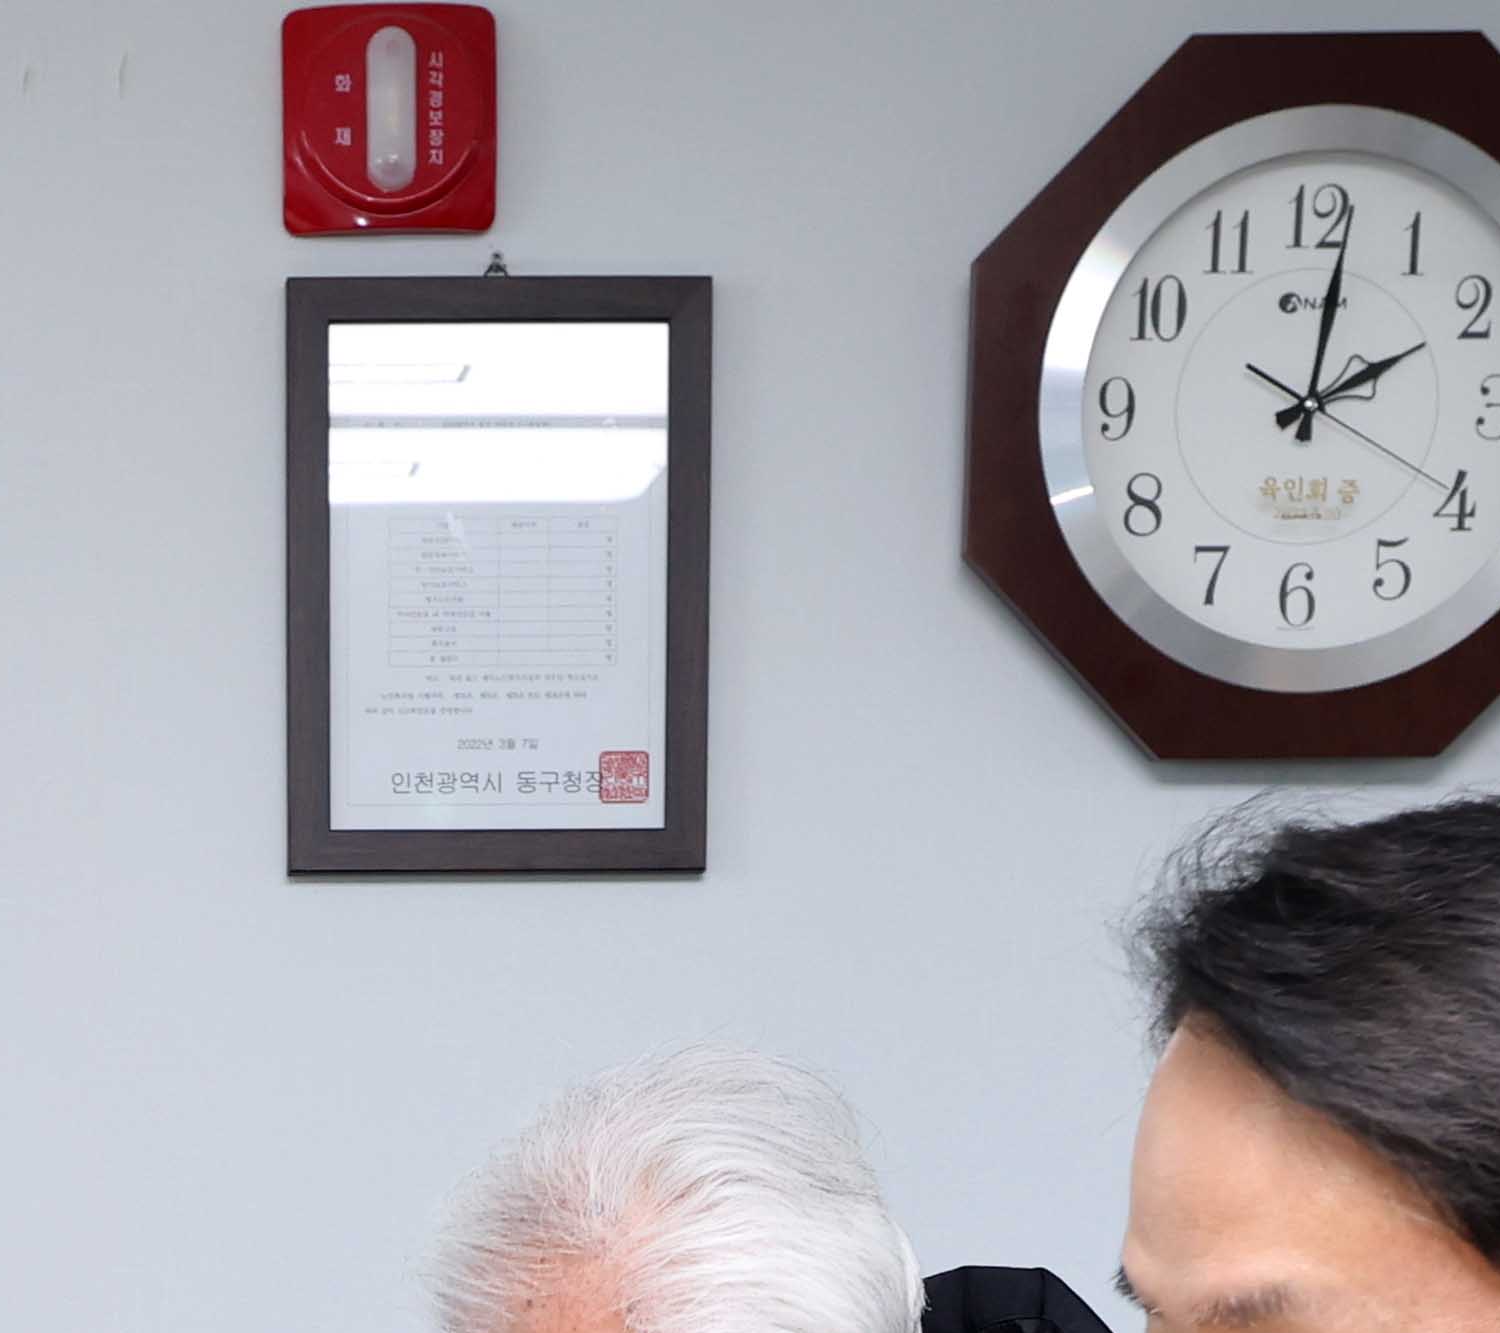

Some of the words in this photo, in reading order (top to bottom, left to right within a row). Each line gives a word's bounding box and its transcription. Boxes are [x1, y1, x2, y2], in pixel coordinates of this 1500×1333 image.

[428, 51, 445, 165] 시각경보장치
[1204, 210, 1255, 276] 11
[1284, 183, 1352, 250] 12
[1400, 210, 1425, 277] 1
[1129, 274, 1188, 342] 10
[1455, 274, 1494, 341] 2
[1098, 375, 1137, 441] 9
[1123, 472, 1164, 538] 8
[1432, 468, 1478, 533] 4
[1193, 544, 1231, 606] 7
[1278, 562, 1316, 628] 6
[1372, 537, 1413, 602] 5
[390, 770, 504, 796] 인천광역시
[516, 769, 606, 796] 동구청장
